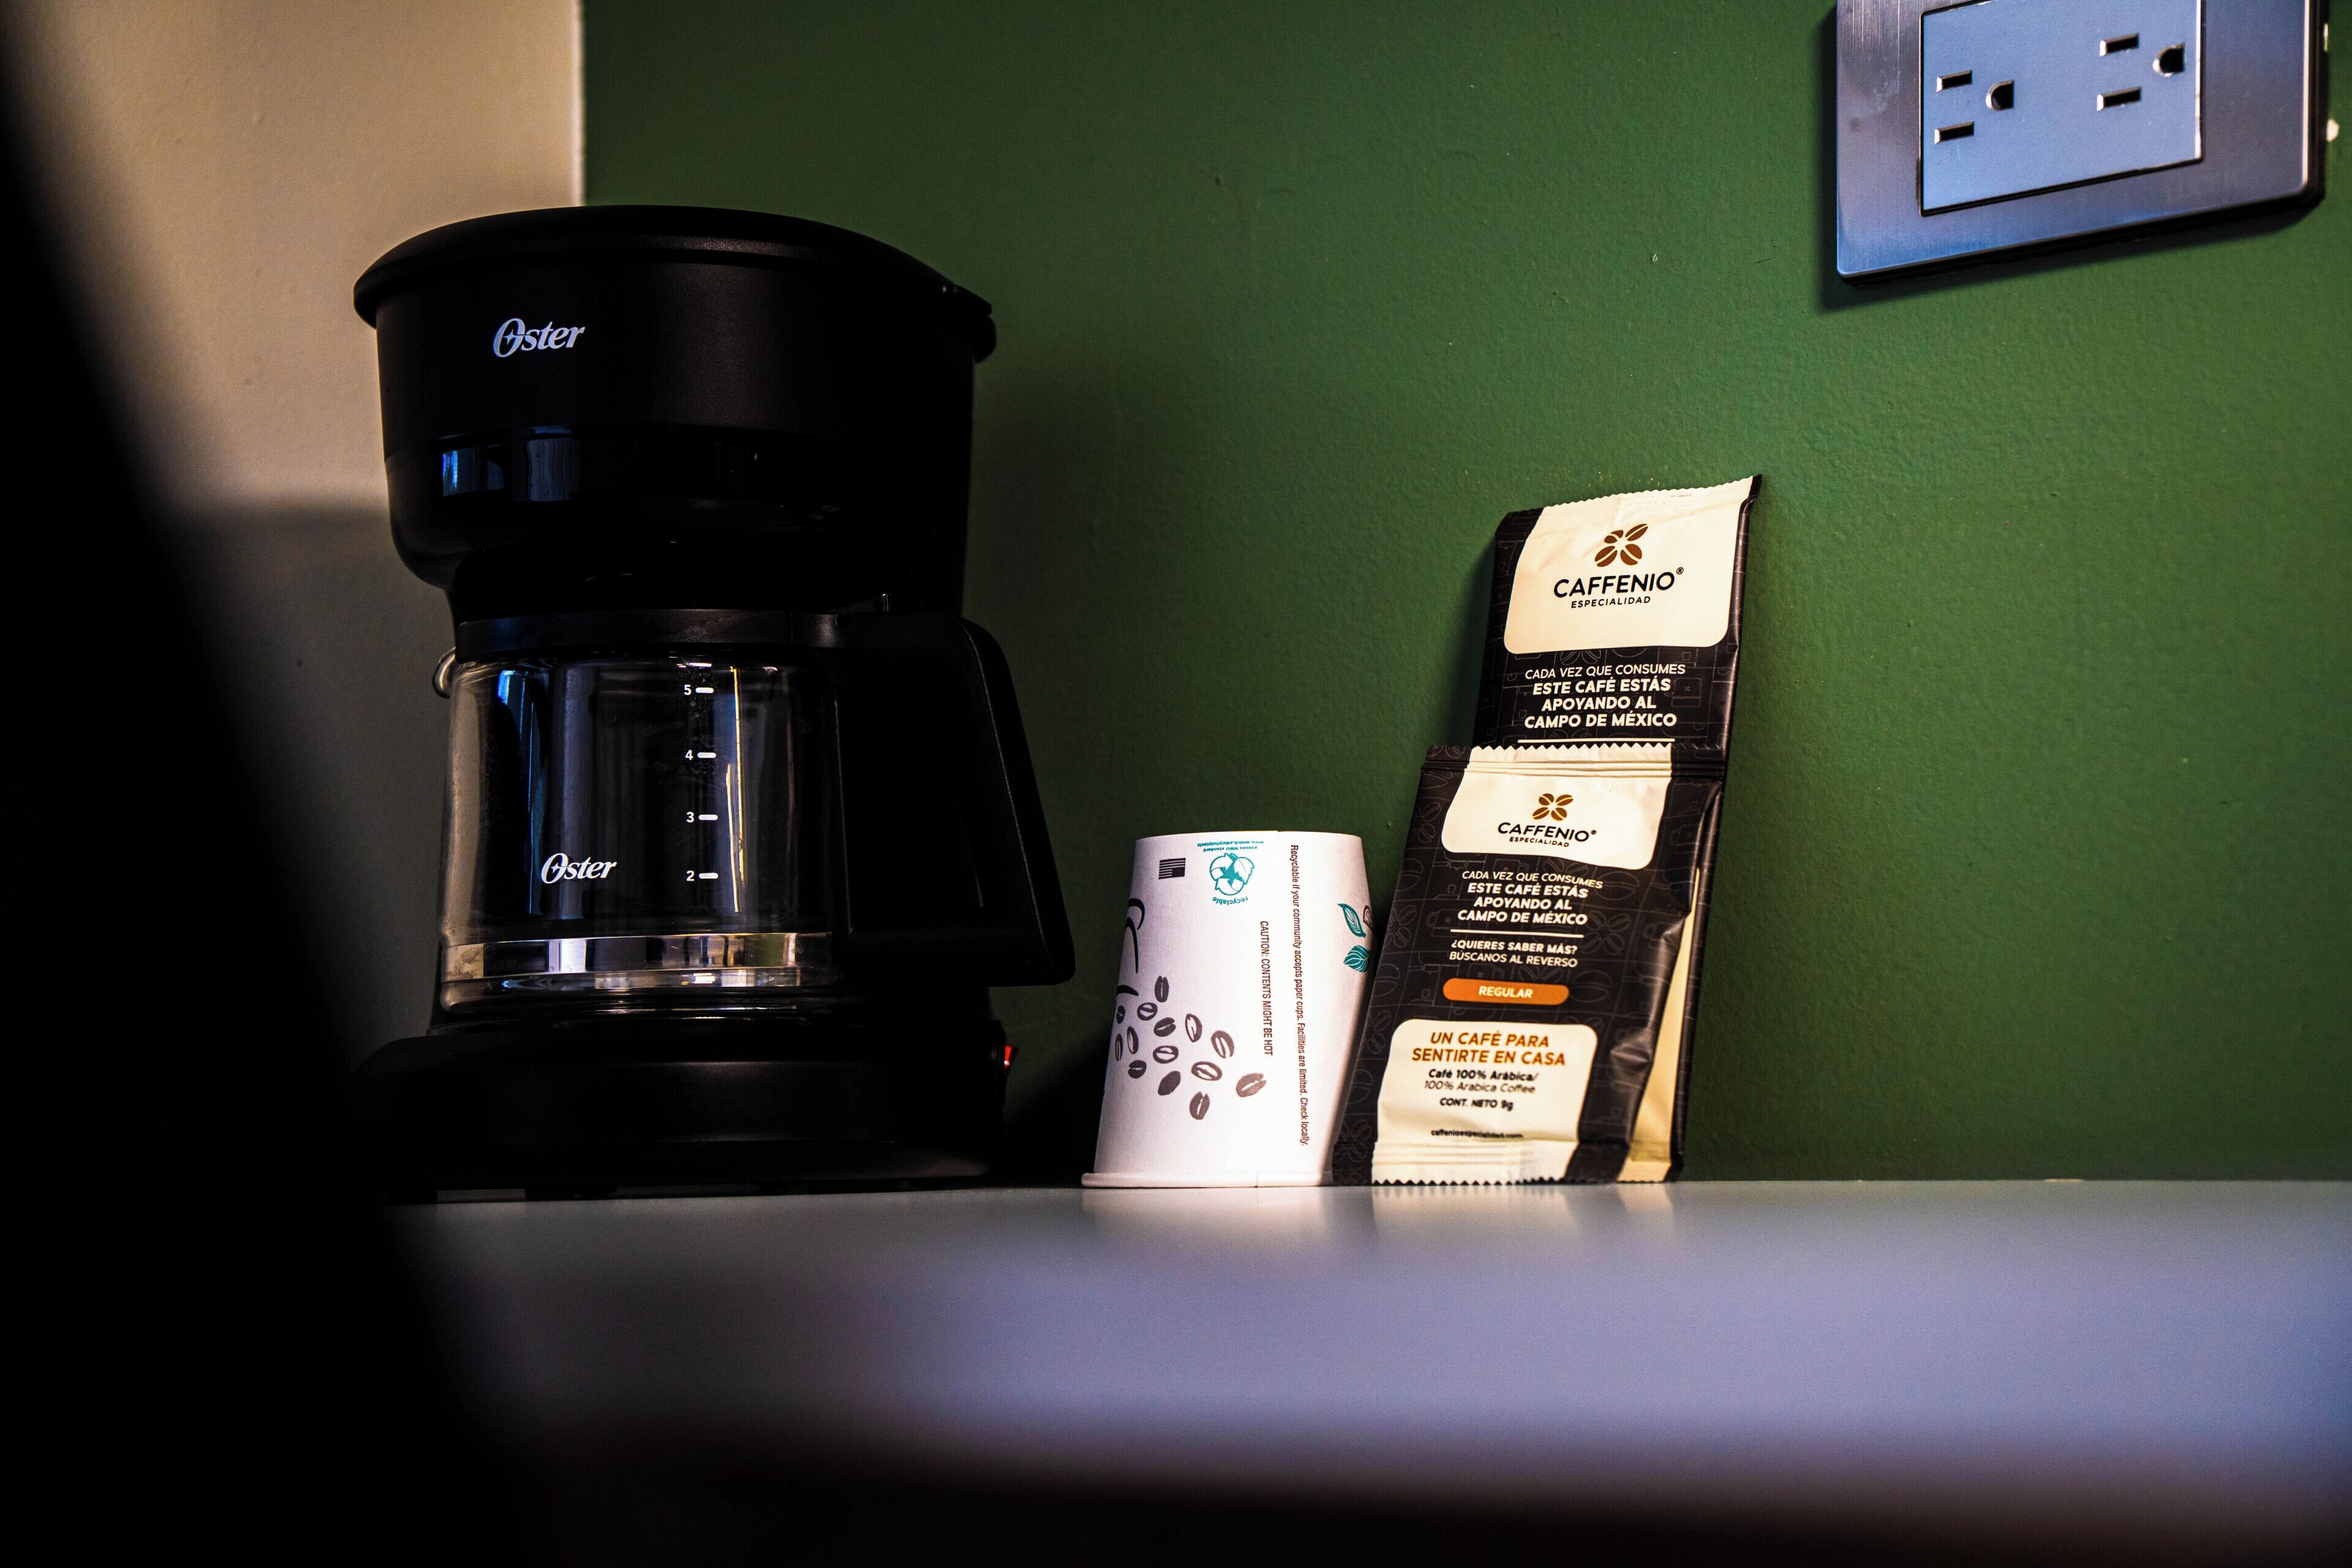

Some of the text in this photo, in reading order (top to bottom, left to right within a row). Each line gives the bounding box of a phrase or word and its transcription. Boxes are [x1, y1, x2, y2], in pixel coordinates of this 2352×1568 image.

[492, 317, 586, 358] Oster
[1570, 596, 1651, 608] ESPECIALIDAD
[1525, 664, 1686, 679] CADA VEZ QUE CONSUMES
[684, 684, 692, 695] 5
[1532, 675, 1671, 695] ESTE CAFÉ ESTÁS
[1542, 696, 1657, 712] APOYANDO AL
[1524, 710, 1678, 729] CAMPO DE MÉXICO
[685, 750, 693, 760] 4
[686, 812, 695, 823] 3
[1509, 836, 1569, 848] ESPECIALIDAD
[541, 853, 617, 884] Oster
[1289, 845, 1300, 883] Recyclable
[686, 870, 695, 881] 2
[1461, 870, 1604, 889] CADA VEZ QUE CONSUMES
[1291, 890, 1300, 907] your
[1468, 881, 1588, 899] ESTE CAFÉ ESTÁS
[1212, 896, 1248, 905] recyclable
[1474, 897, 1573, 911] APOYANDO AL
[1457, 910, 1588, 926] CAMPO DE MÉXICO
[1292, 908, 1302, 949] community
[1452, 940, 1578, 955] ¿QUIERES SABER MÁS?
[1293, 950, 1303, 978] accepts
[1509, 954, 1523, 963] AL
[1526, 955, 1578, 968] REVERSO
[1259, 921, 1273, 1056] CAUTION: CONTENTS MIGHT BE HOT
[1294, 979, 1303, 1000] paper
[1478, 985, 1533, 999] REGULAR
[1295, 1001, 1304, 1021] cups.
[1297, 1022, 1306, 1054] Facilities
[1430, 1030, 1549, 1048] UN CAFÉ PARA
[1412, 1047, 1566, 1066] SENTIRTE EN CASA
[1299, 1068, 1308, 1095] limited.
[1428, 1068, 1453, 1079] Café
[1455, 1069, 1487, 1080] 100%
[1424, 1080, 1536, 1094] 100% Arabica Coffee
[1471, 1099, 1498, 1109] NETO
[1300, 1121, 1310, 1147] locally.
